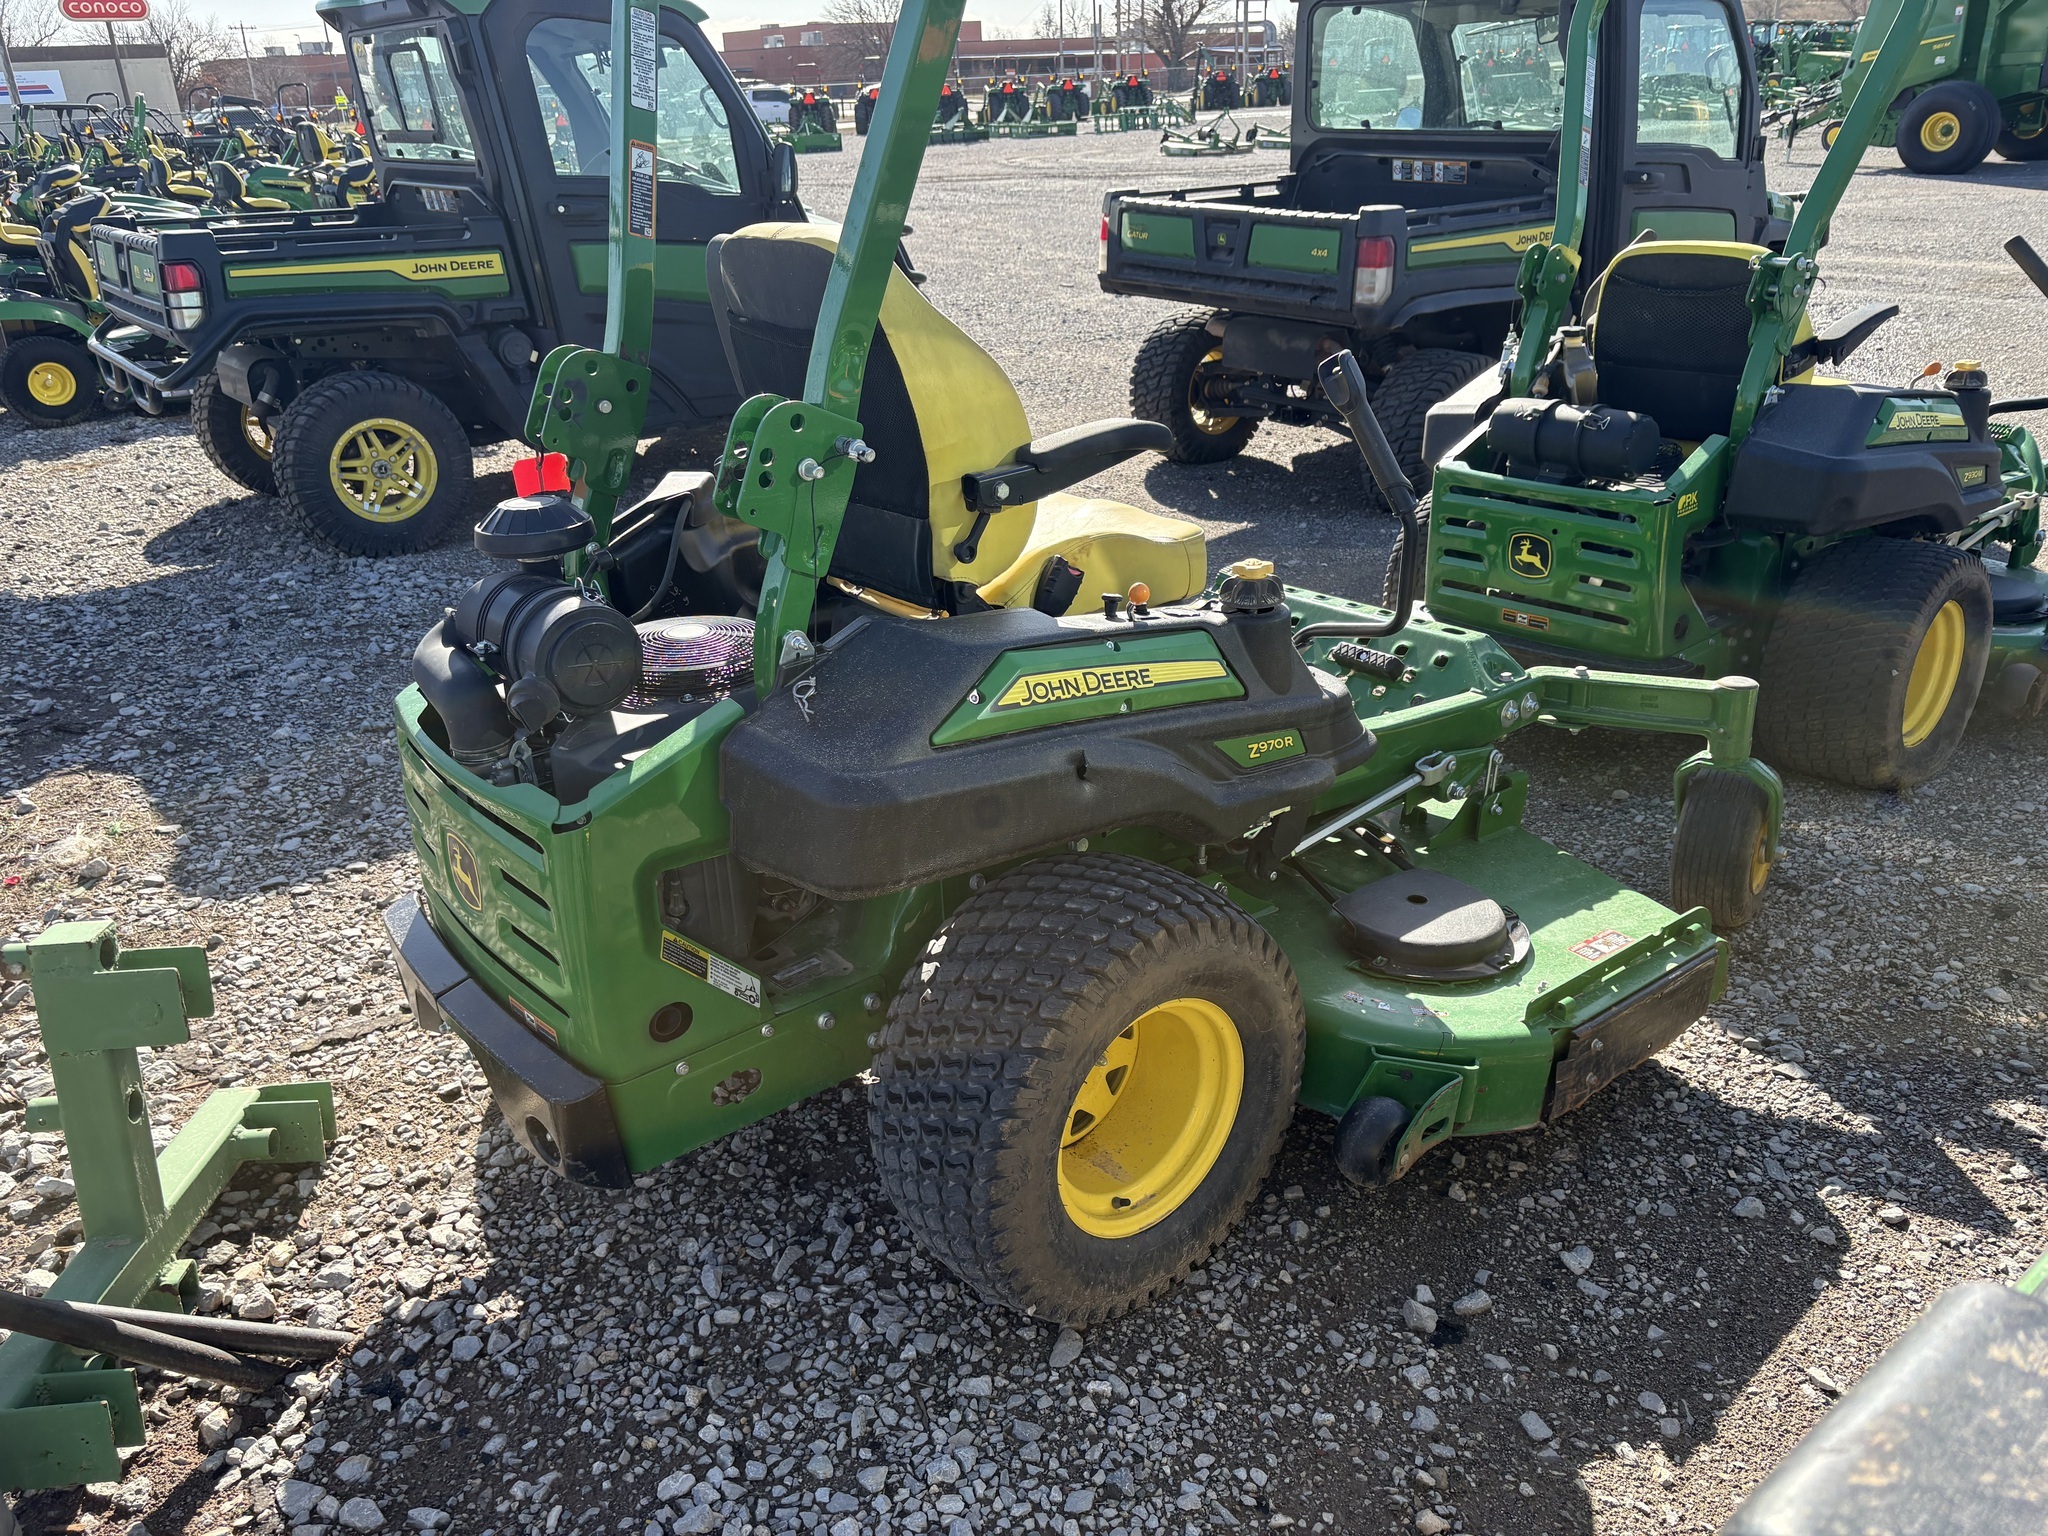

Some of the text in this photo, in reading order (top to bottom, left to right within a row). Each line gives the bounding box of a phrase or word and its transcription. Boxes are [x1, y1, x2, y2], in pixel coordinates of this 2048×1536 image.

[1516, 234, 1538, 245] JOHN
[412, 260, 494, 274] JOHN DEERE
[1896, 413, 1940, 428] JOHN DEERE
[1021, 668, 1155, 703] JOHN DEERE
